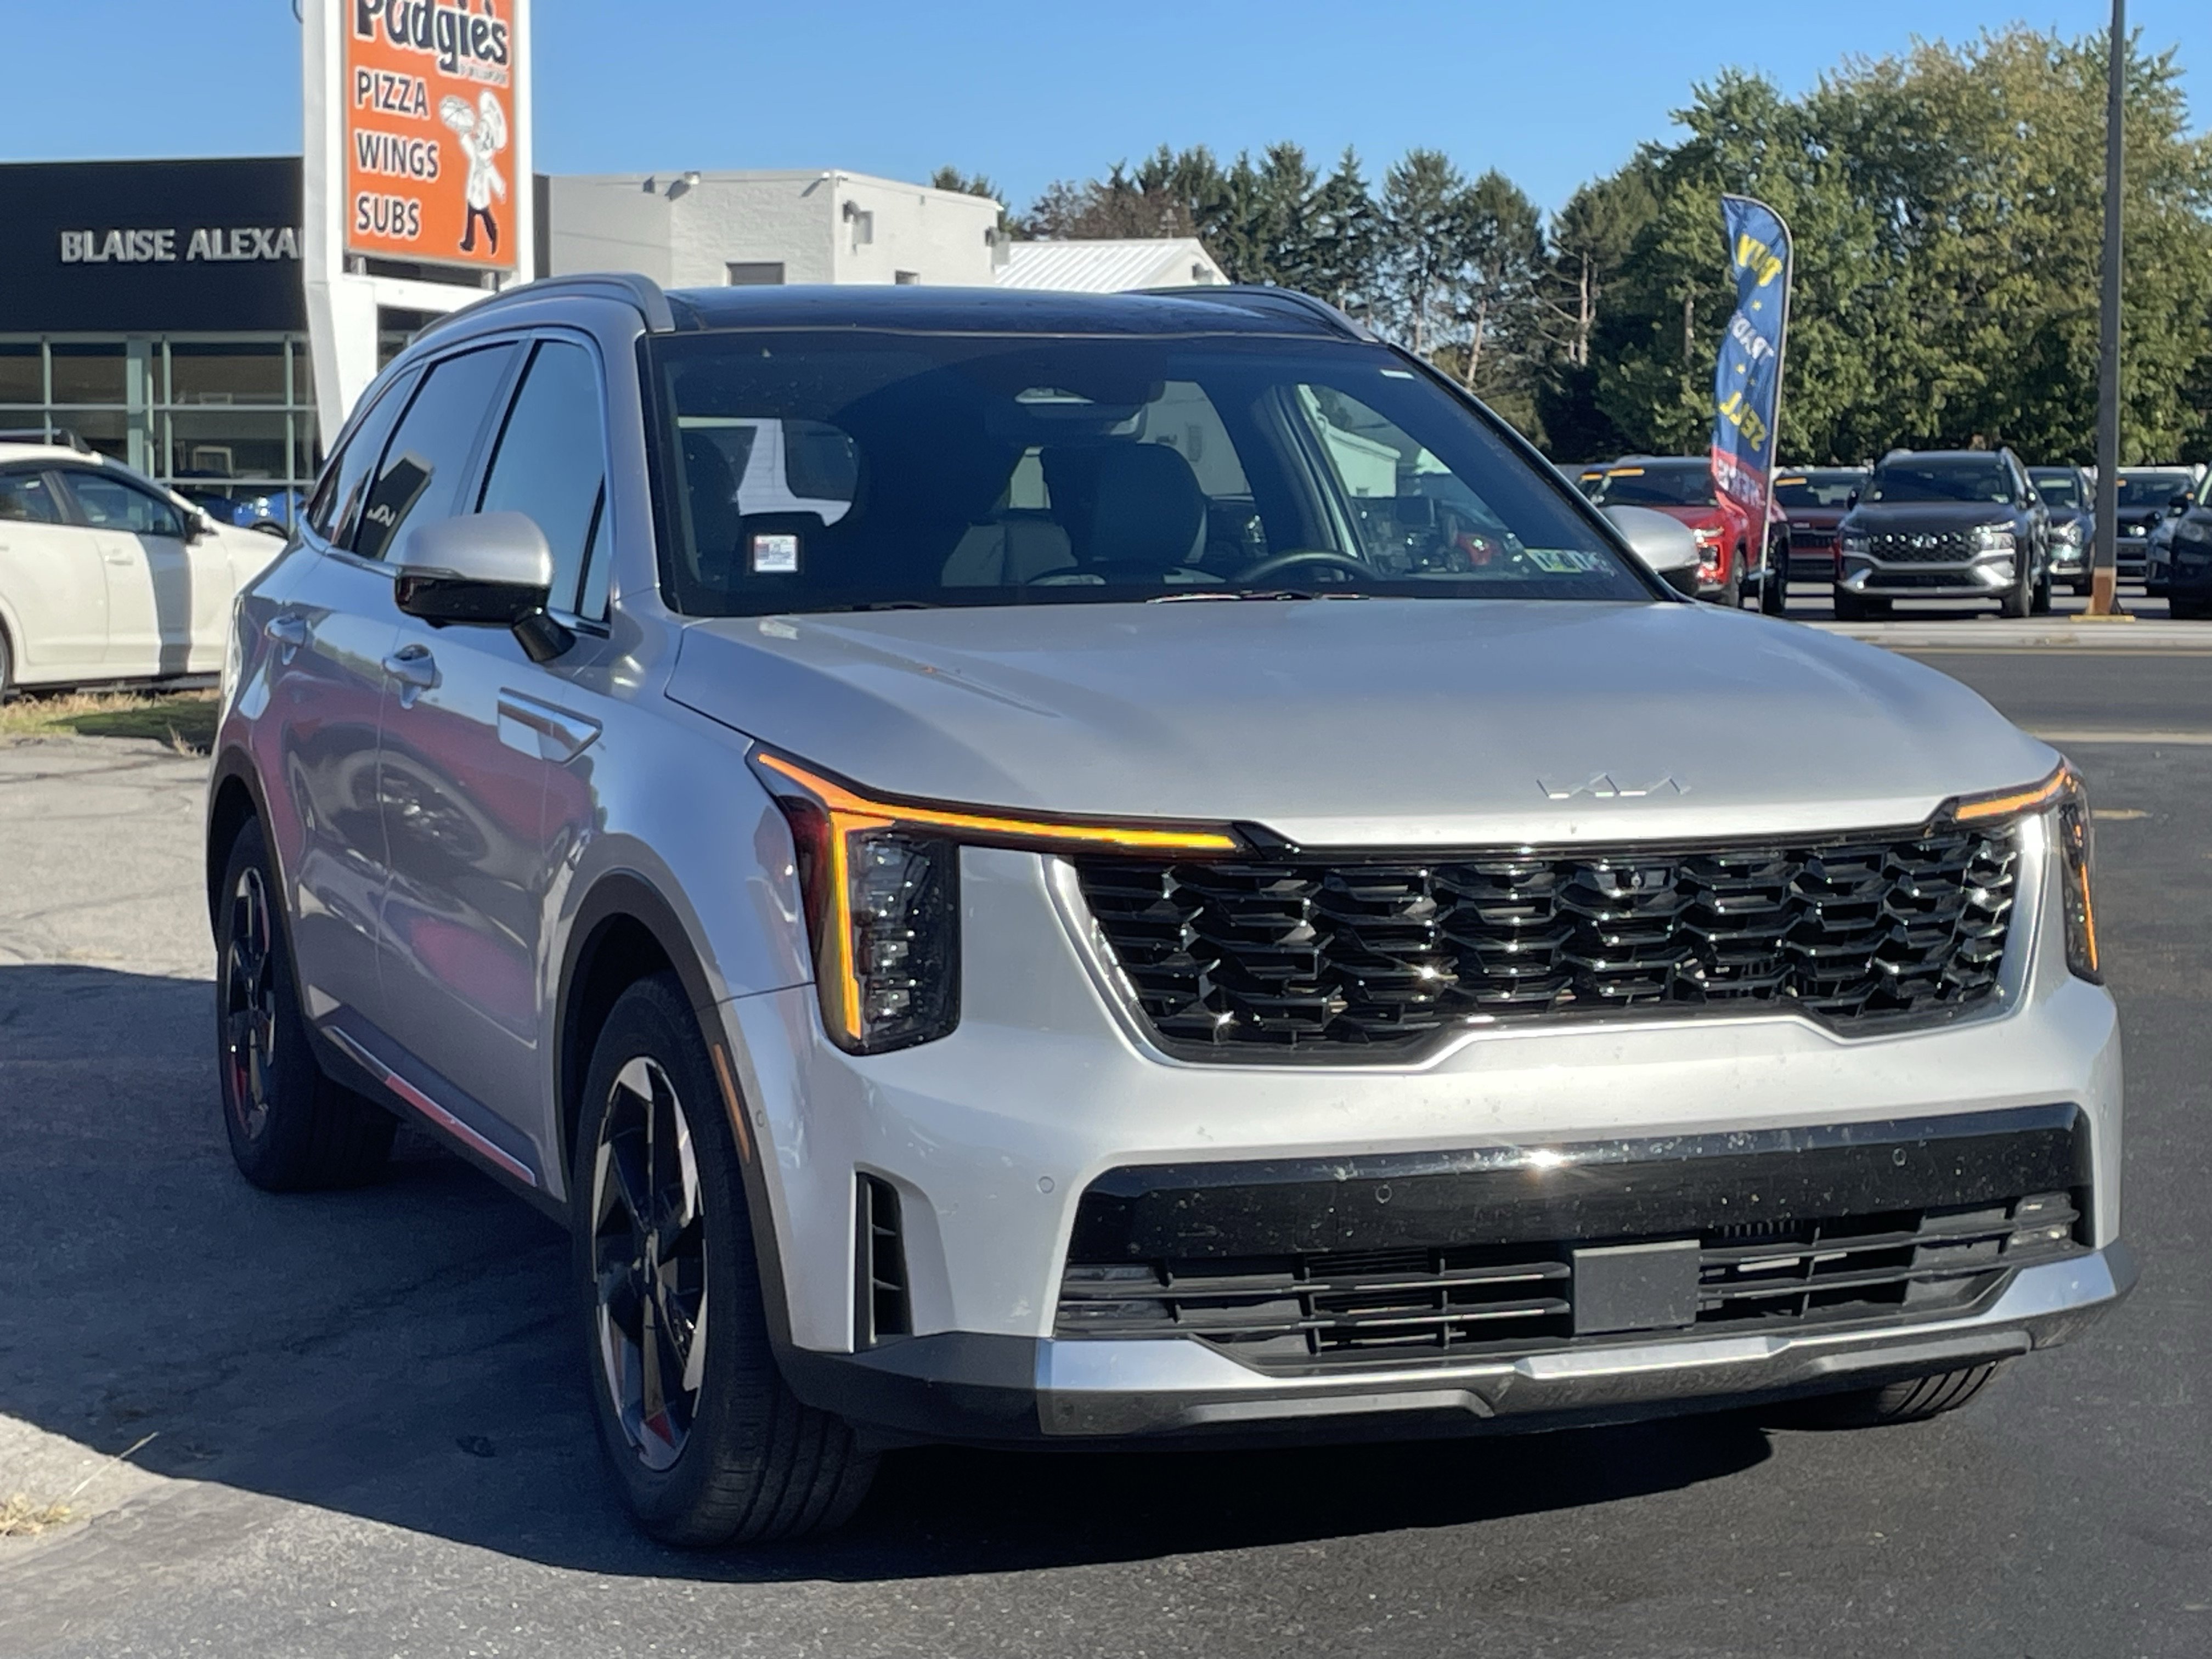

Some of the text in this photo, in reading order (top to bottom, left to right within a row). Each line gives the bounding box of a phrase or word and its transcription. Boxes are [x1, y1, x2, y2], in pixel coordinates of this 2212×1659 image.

[357, 70, 428, 117] PIZZA
[357, 132, 438, 178] WINGS
[358, 196, 420, 237] SUBS
[61, 227, 304, 263] BLAISE ALEXA
